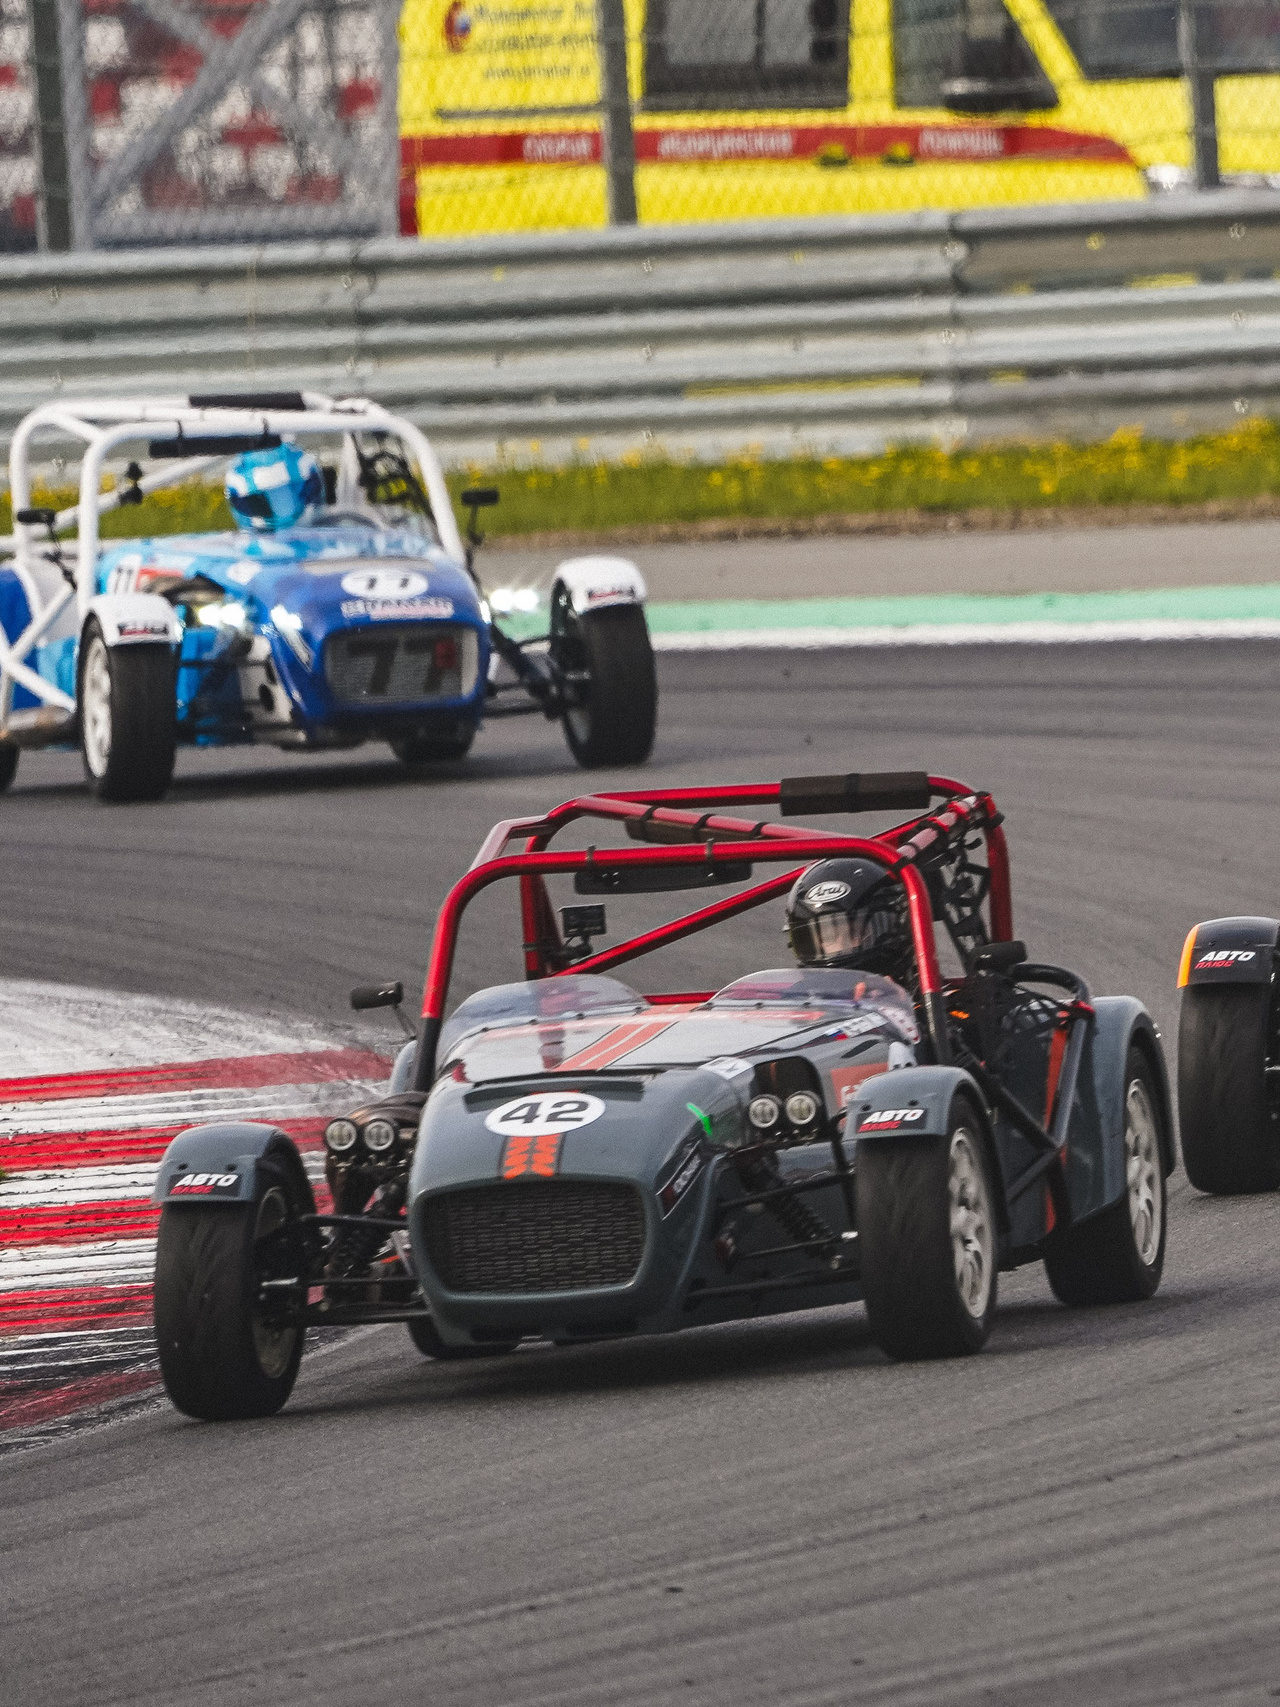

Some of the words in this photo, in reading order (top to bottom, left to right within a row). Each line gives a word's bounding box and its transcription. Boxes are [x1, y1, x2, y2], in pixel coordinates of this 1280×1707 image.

[1199, 950, 1256, 962] АВТО
[499, 1100, 589, 1124] 42
[862, 1109, 925, 1124] АВТО
[175, 1173, 239, 1187] АВТО
